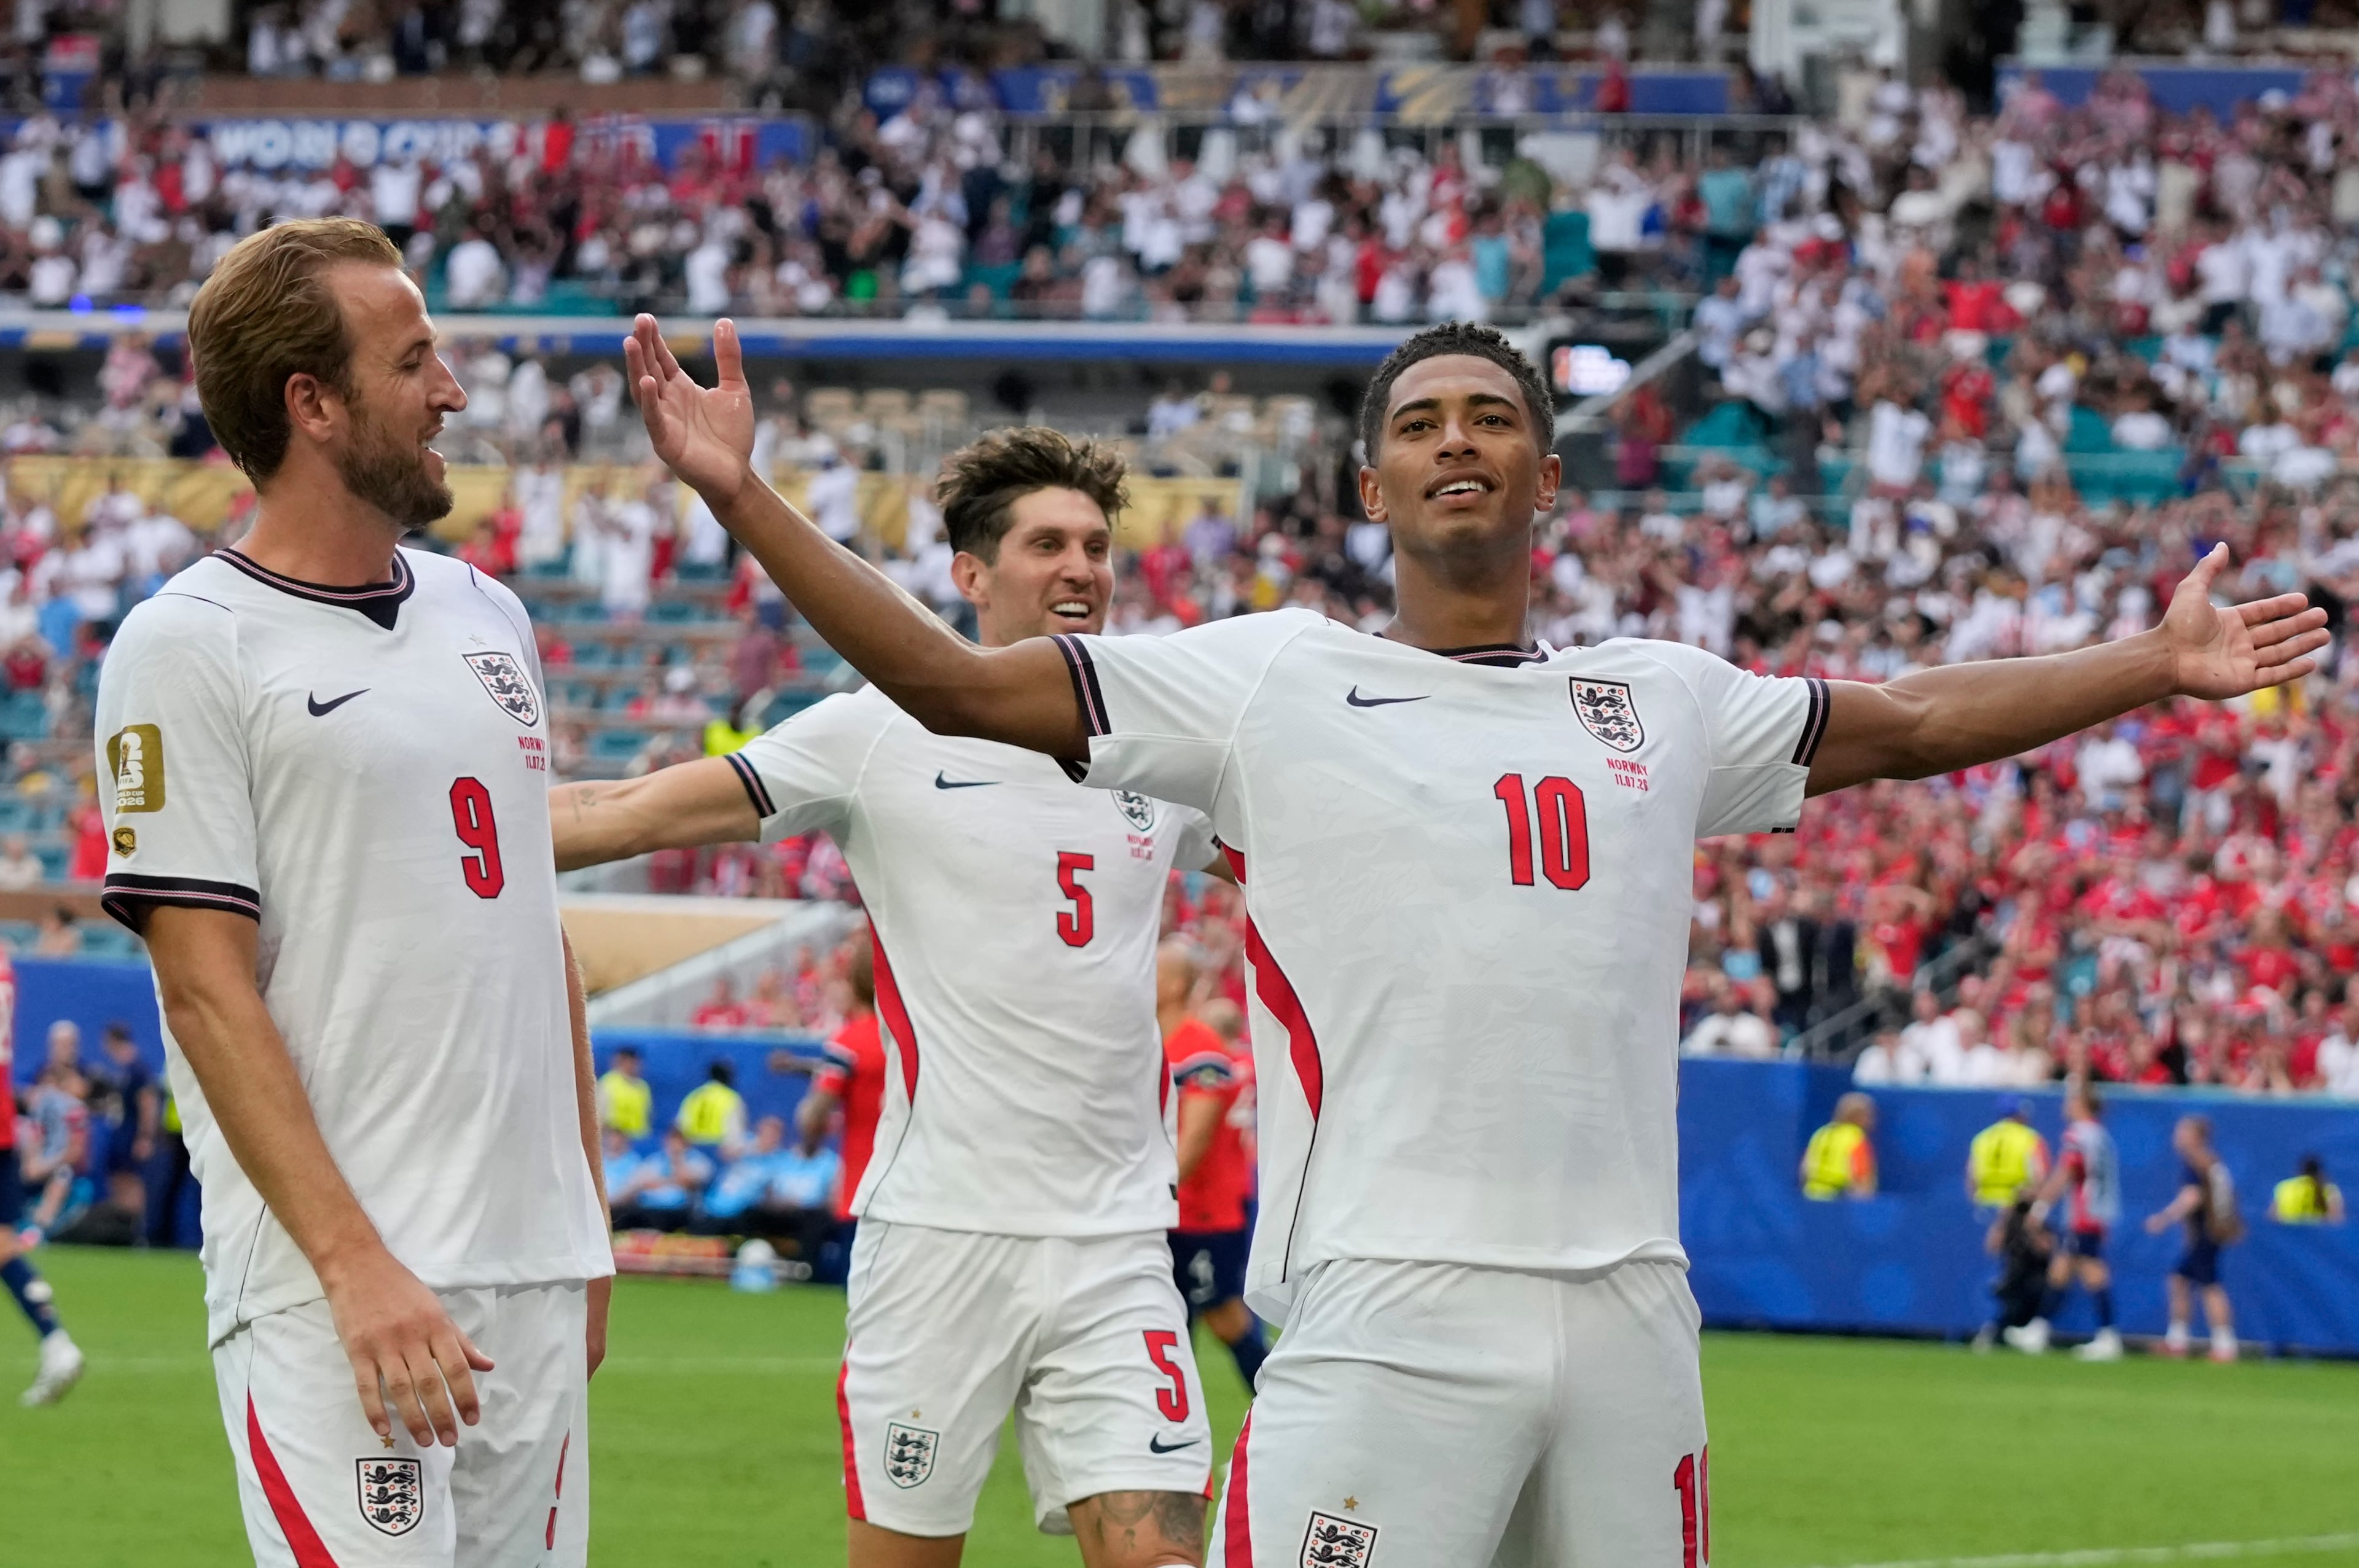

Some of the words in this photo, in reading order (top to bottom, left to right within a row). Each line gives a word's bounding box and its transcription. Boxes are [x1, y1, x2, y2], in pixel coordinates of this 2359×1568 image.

[1606, 758, 1648, 775] NORWAY
[1614, 773, 1648, 792] 11.07.26
[450, 776, 504, 899] 9
[1493, 773, 1590, 891] 10
[1057, 851, 1093, 947] 5
[1143, 1330, 1189, 1423] 5
